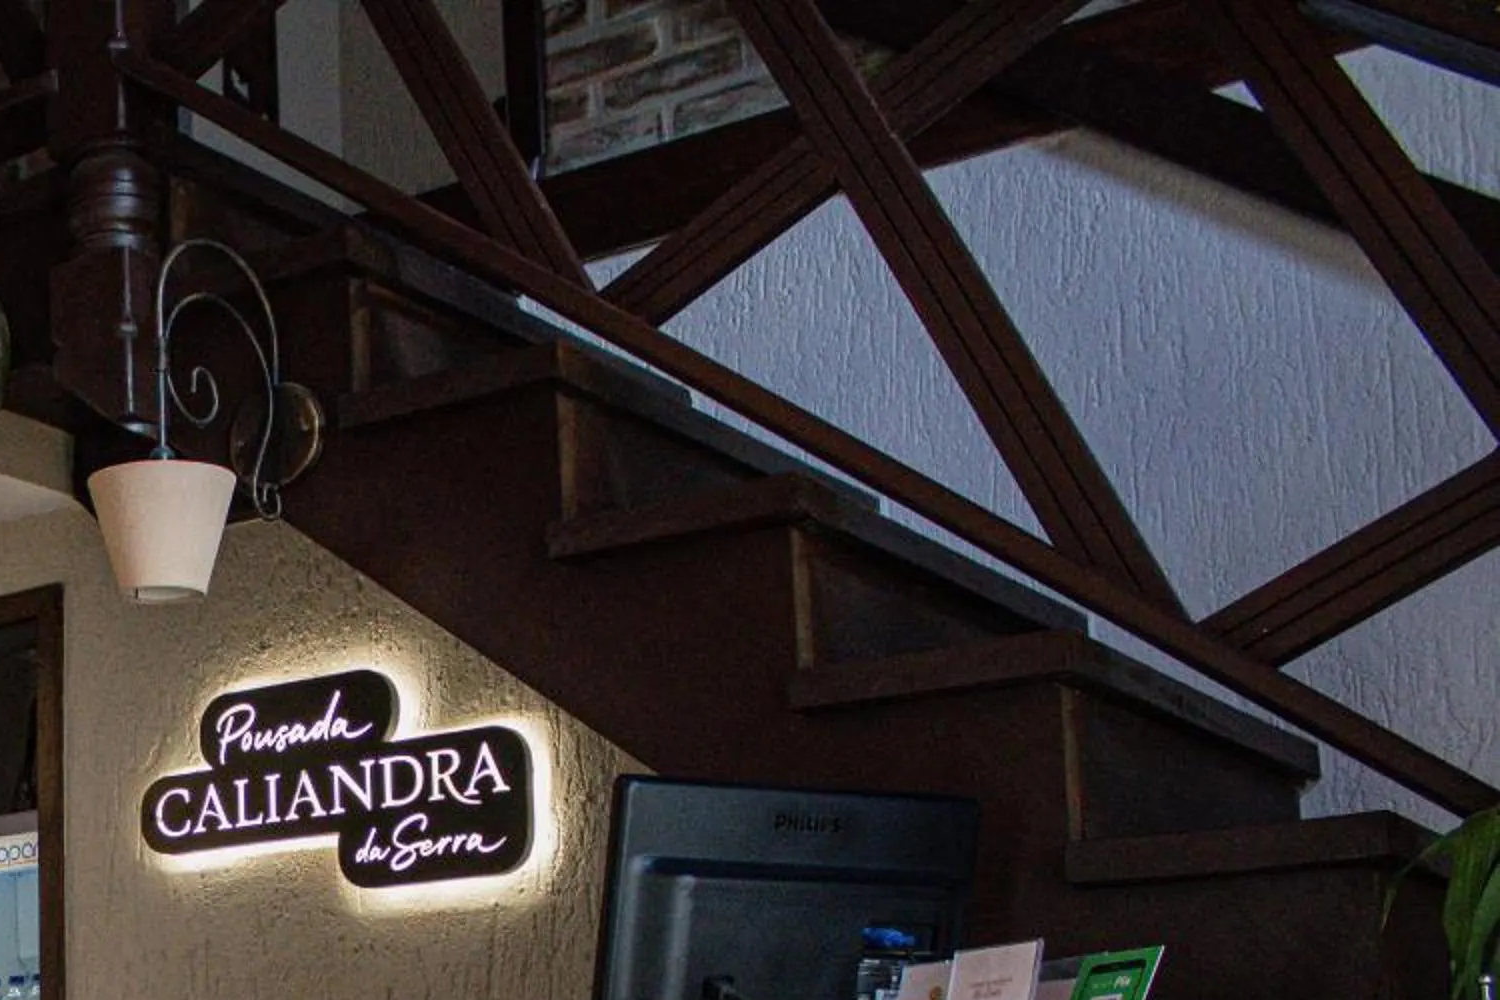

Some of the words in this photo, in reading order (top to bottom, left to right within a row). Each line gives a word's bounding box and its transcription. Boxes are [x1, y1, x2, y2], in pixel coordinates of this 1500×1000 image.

[216, 689, 373, 766] Pousada
[155, 740, 511, 838] CALIANDRA
[355, 827, 391, 863] da
[389, 813, 508, 872] Serra
